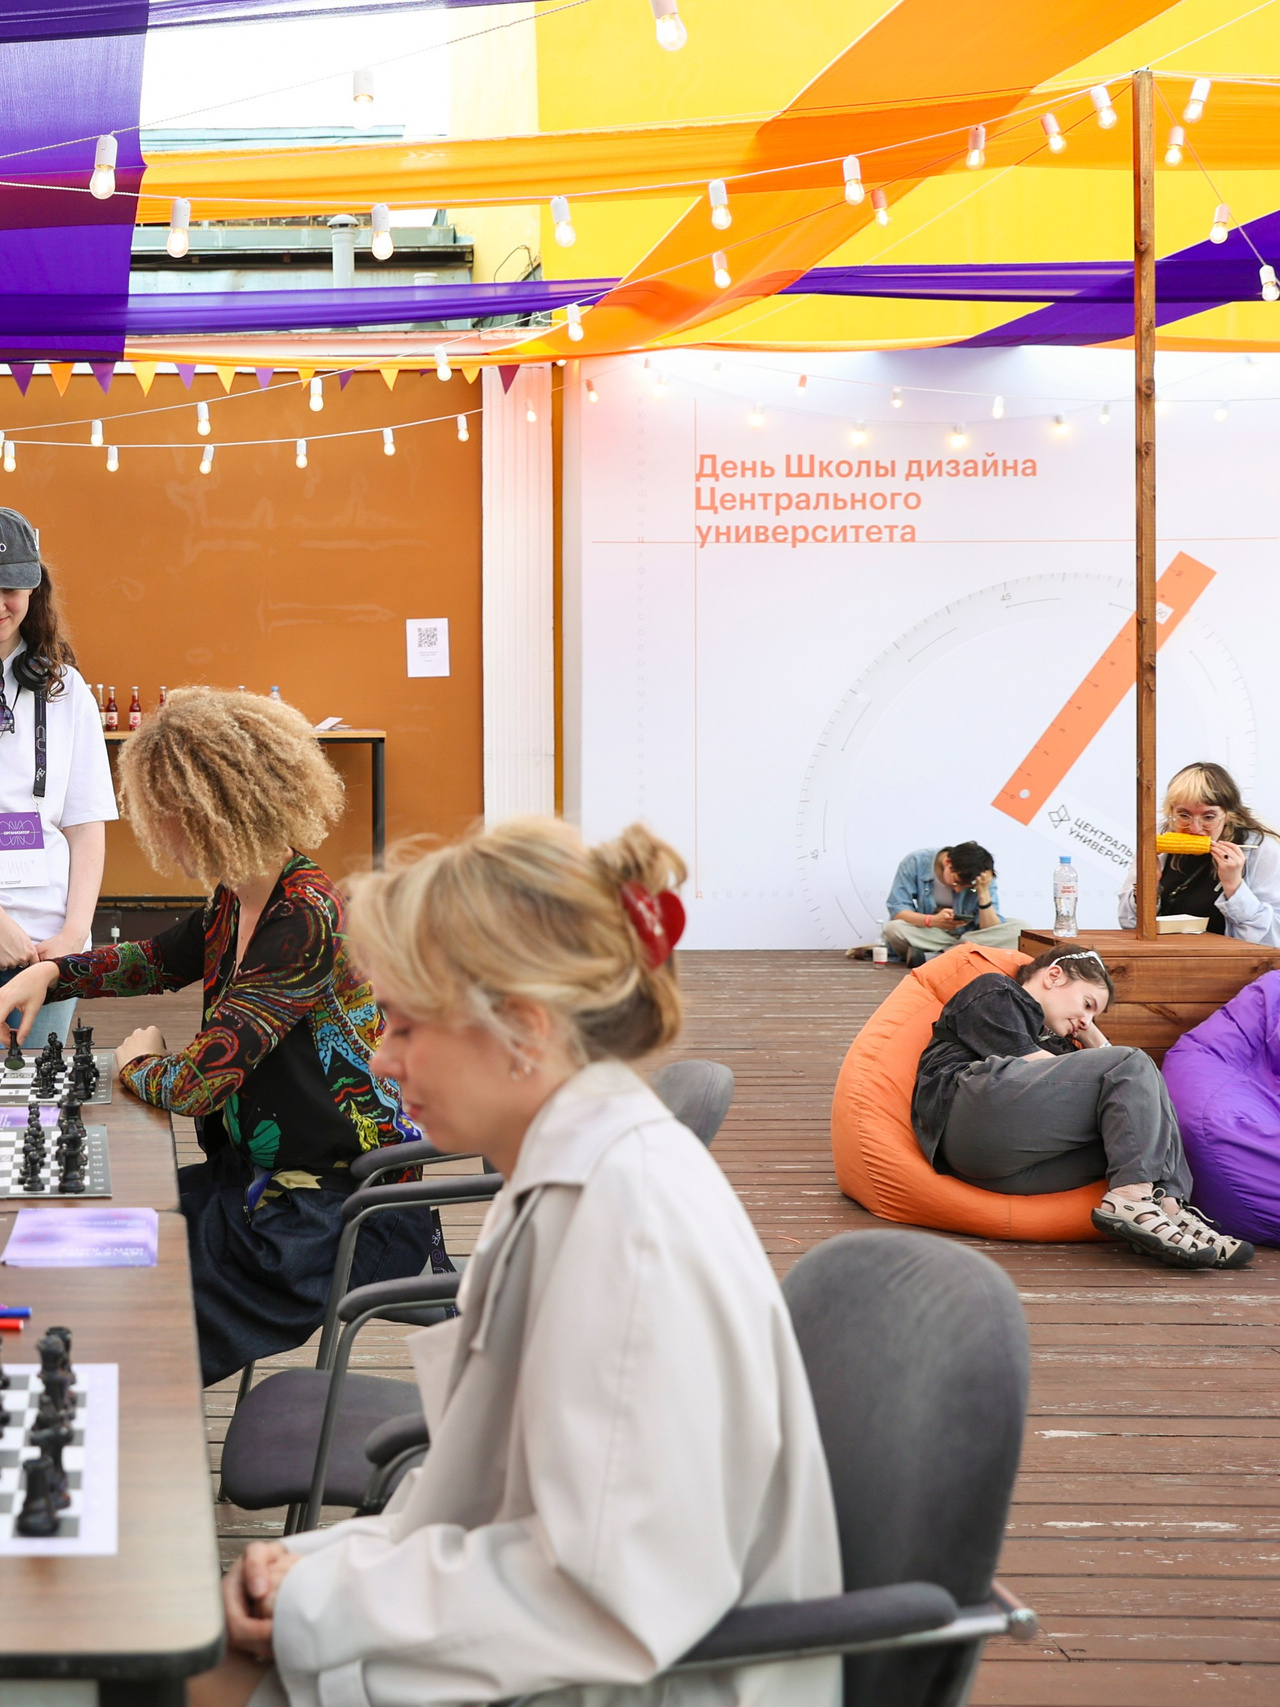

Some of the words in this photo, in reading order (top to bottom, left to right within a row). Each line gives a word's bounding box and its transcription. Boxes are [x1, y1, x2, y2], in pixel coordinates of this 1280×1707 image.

[696, 454, 775, 482] День
[785, 454, 896, 478] Школы
[905, 453, 1038, 482] дизайна
[696, 487, 922, 516] Центрального
[696, 524, 917, 549] университета
[1074, 817, 1135, 859] ЦЕНТРАЛЬ
